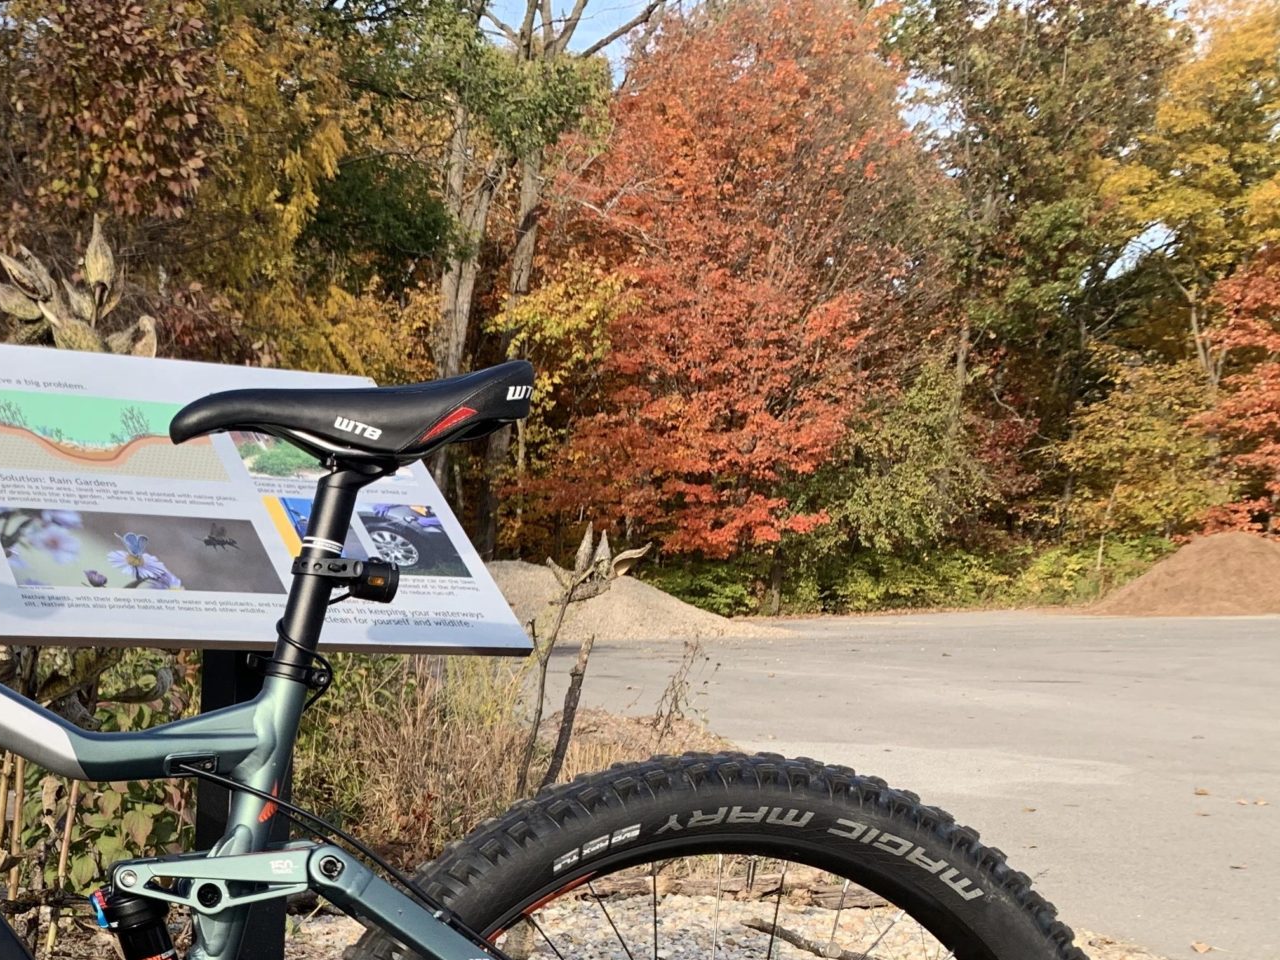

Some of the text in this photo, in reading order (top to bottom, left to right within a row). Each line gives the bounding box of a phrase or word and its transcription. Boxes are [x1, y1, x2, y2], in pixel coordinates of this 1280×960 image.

[25, 378, 40, 388] big
[43, 381, 87, 390] problem.
[334, 416, 382, 440] WTB
[49, 476, 72, 485] Rain
[75, 478, 117, 487] Gardens
[370, 608, 406, 618] keeping
[410, 610, 430, 618] your
[434, 610, 484, 619] waterways
[325, 616, 352, 624] clean
[372, 618, 410, 626] yourself
[433, 619, 474, 628] wildlife.
[654, 806, 984, 901] MAGIC MARY
